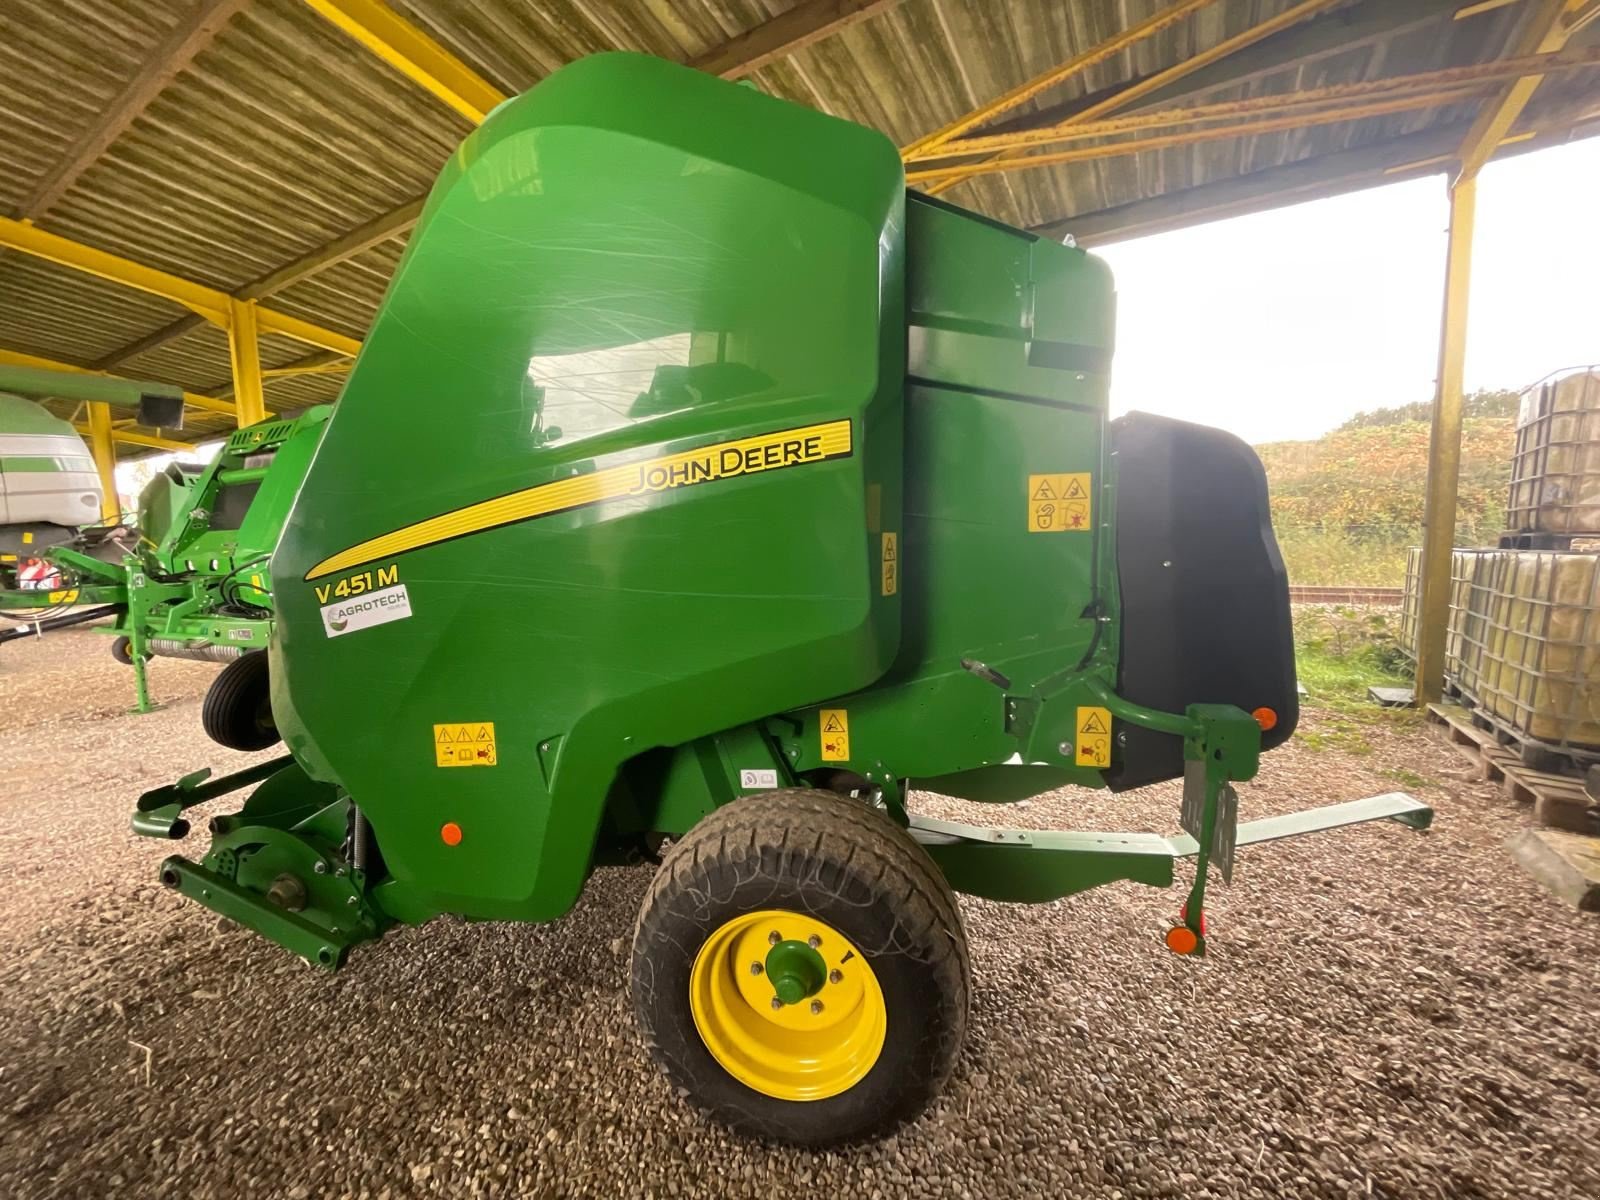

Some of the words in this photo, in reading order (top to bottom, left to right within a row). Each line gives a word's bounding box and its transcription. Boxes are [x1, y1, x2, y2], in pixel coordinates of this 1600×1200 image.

[630, 457, 710, 492] JOHN
[720, 436, 822, 474] DEERE
[315, 583, 331, 604] V
[335, 572, 372, 597] 451
[377, 564, 398, 587] M
[337, 592, 406, 618] AGROTECH
